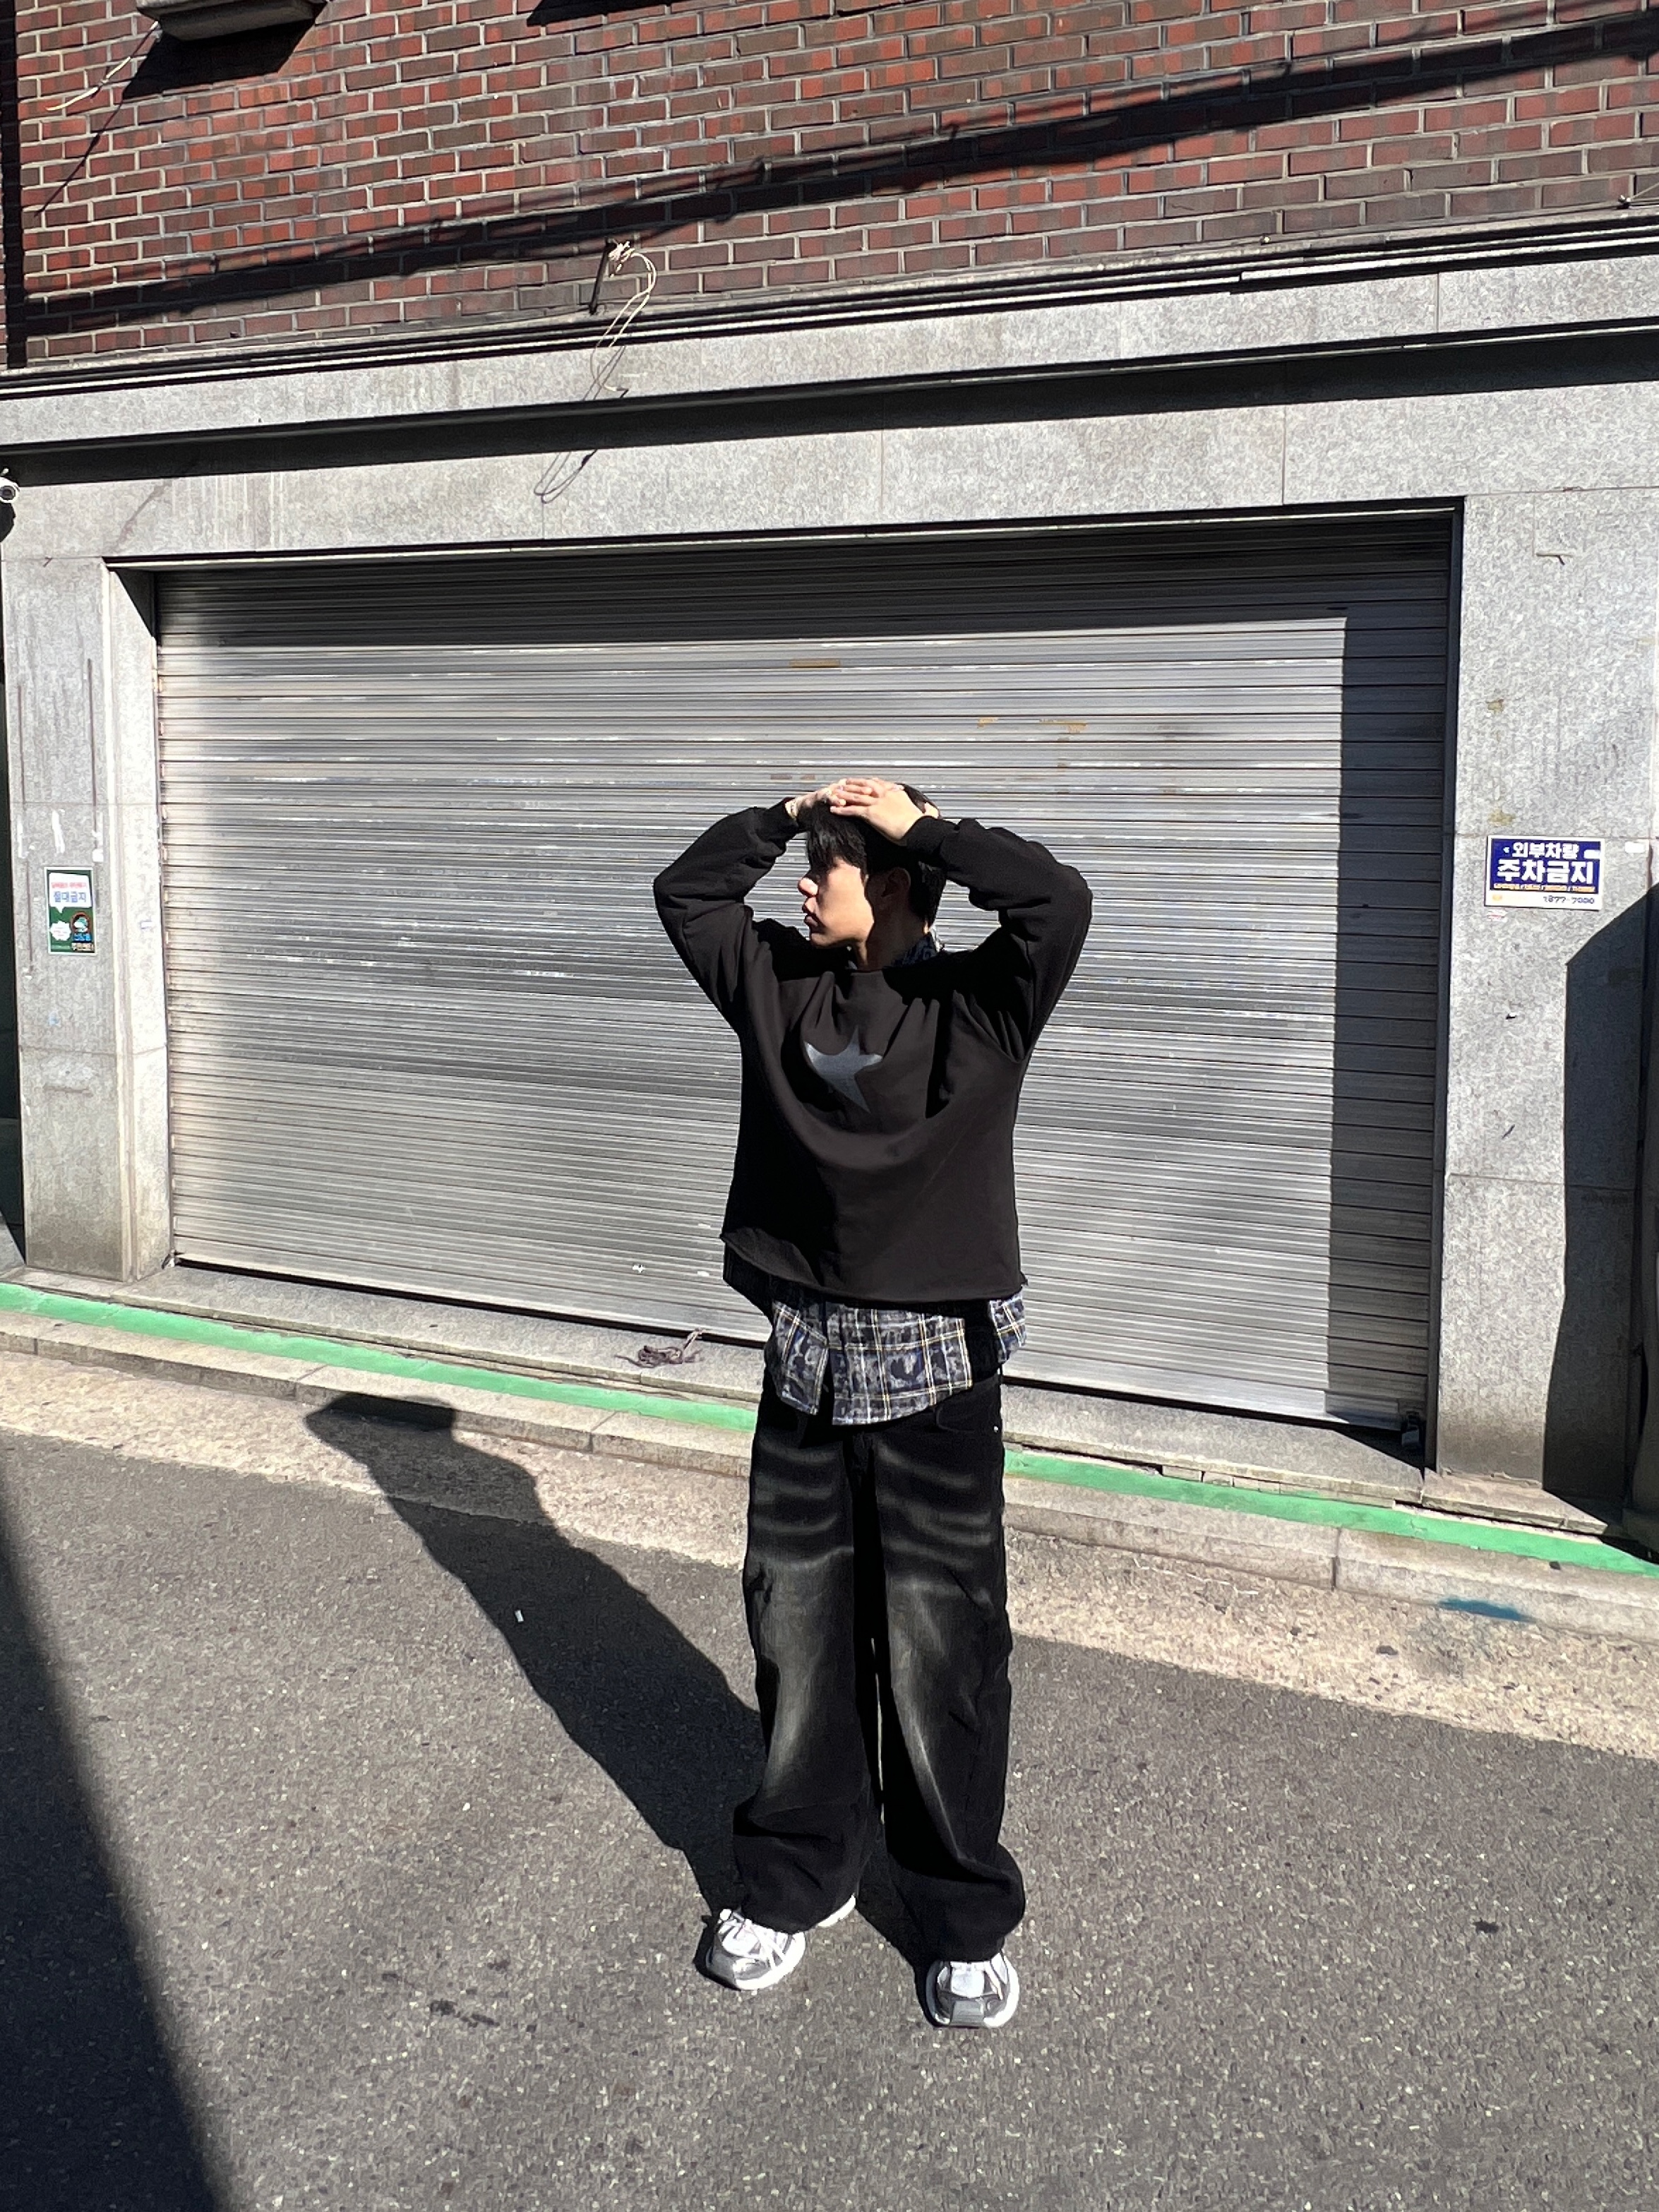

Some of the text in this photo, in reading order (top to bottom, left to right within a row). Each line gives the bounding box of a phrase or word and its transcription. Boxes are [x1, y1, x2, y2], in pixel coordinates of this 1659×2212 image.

[1512, 842, 1579, 859] 외부차량
[1497, 859, 1594, 884] 주차금지
[54, 891, 87, 903] 절대금지
